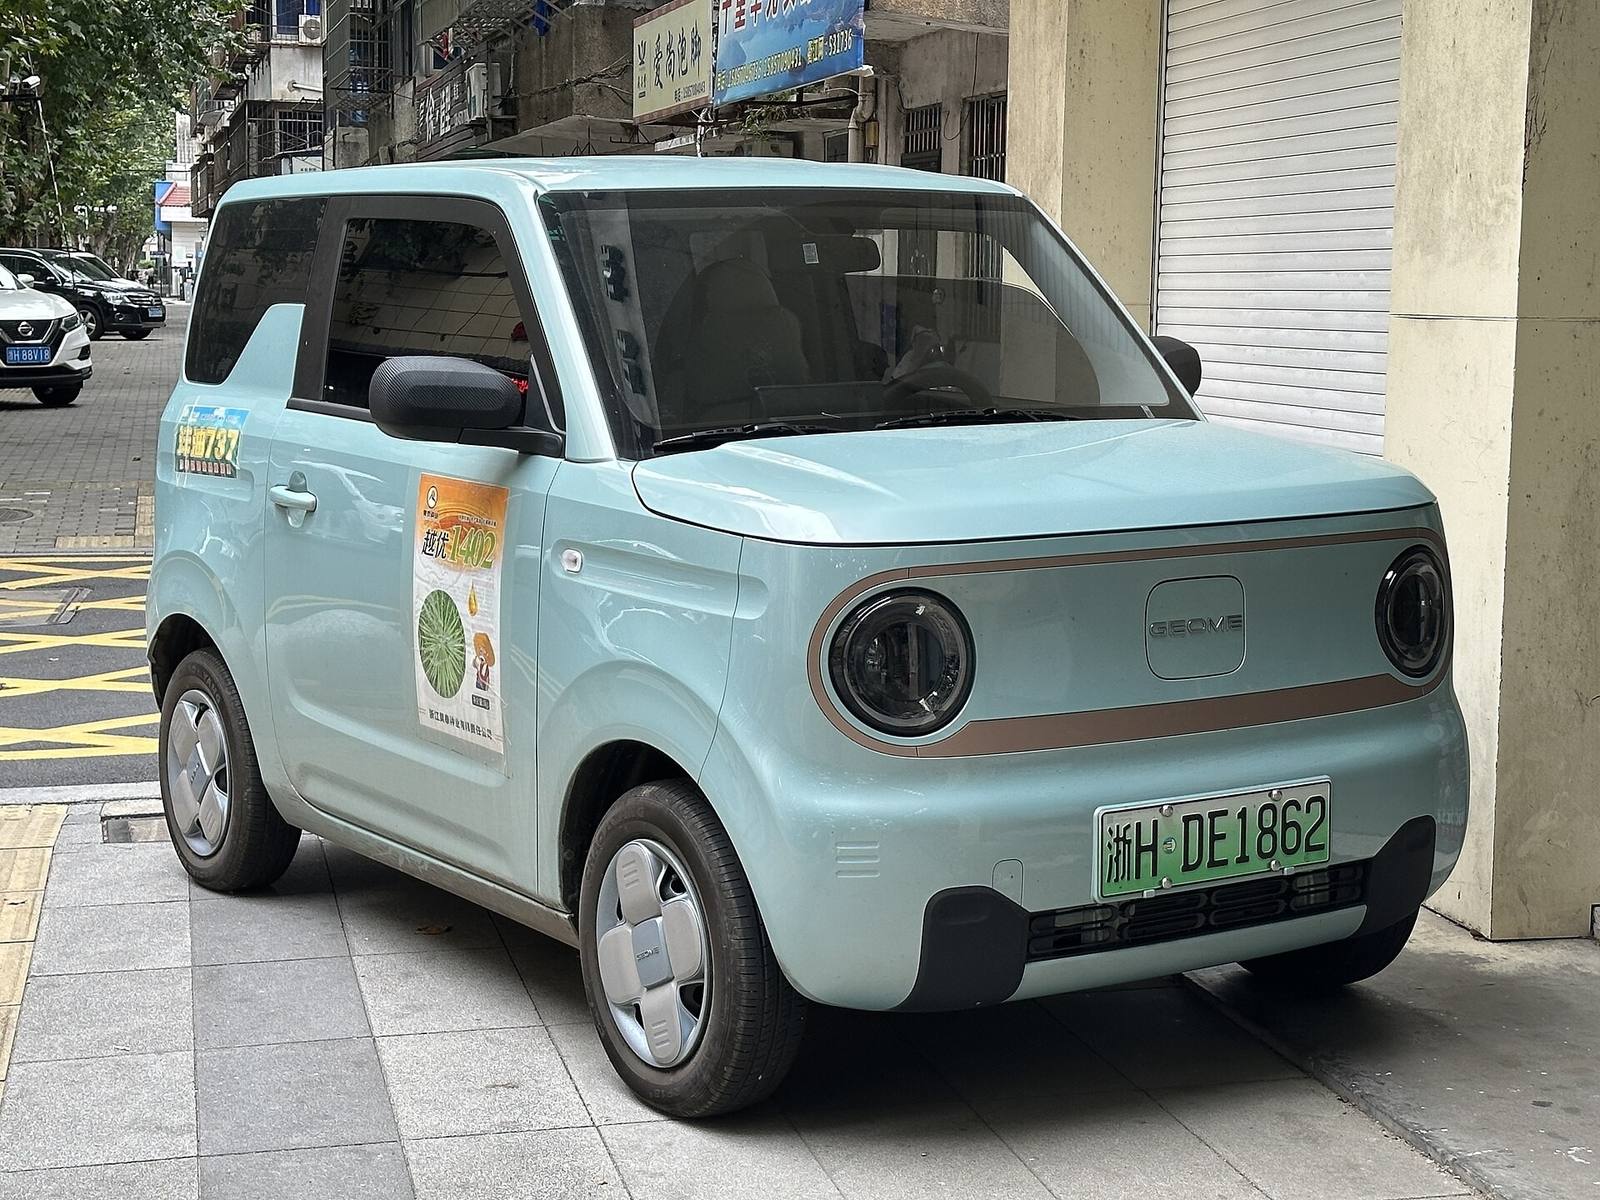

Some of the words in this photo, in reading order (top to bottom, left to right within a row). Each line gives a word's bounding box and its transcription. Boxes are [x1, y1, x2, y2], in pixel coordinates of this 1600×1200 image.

[1148, 614, 1243, 638] GEOME
[1105, 819, 1159, 883] 浙H
[1180, 794, 1327, 873] DE1862
